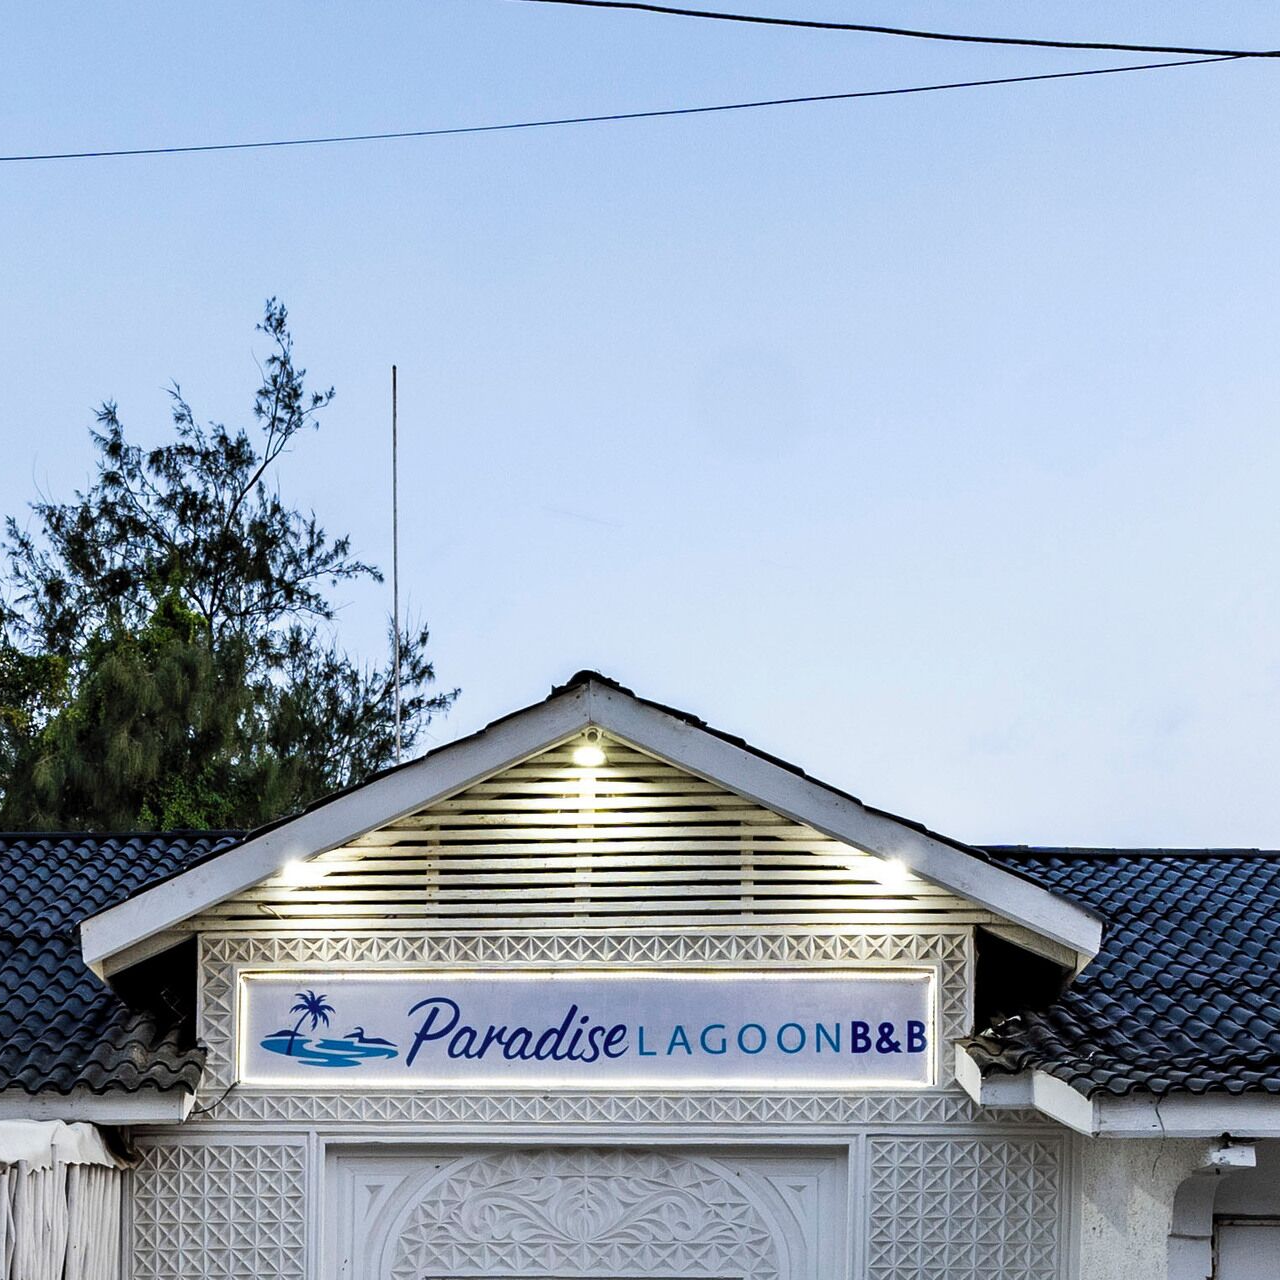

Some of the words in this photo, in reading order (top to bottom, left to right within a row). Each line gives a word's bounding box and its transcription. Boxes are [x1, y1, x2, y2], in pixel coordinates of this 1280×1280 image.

[405, 996, 630, 1067] Paradise
[639, 1021, 841, 1056] LAGOON
[850, 1020, 928, 1055] B&B
